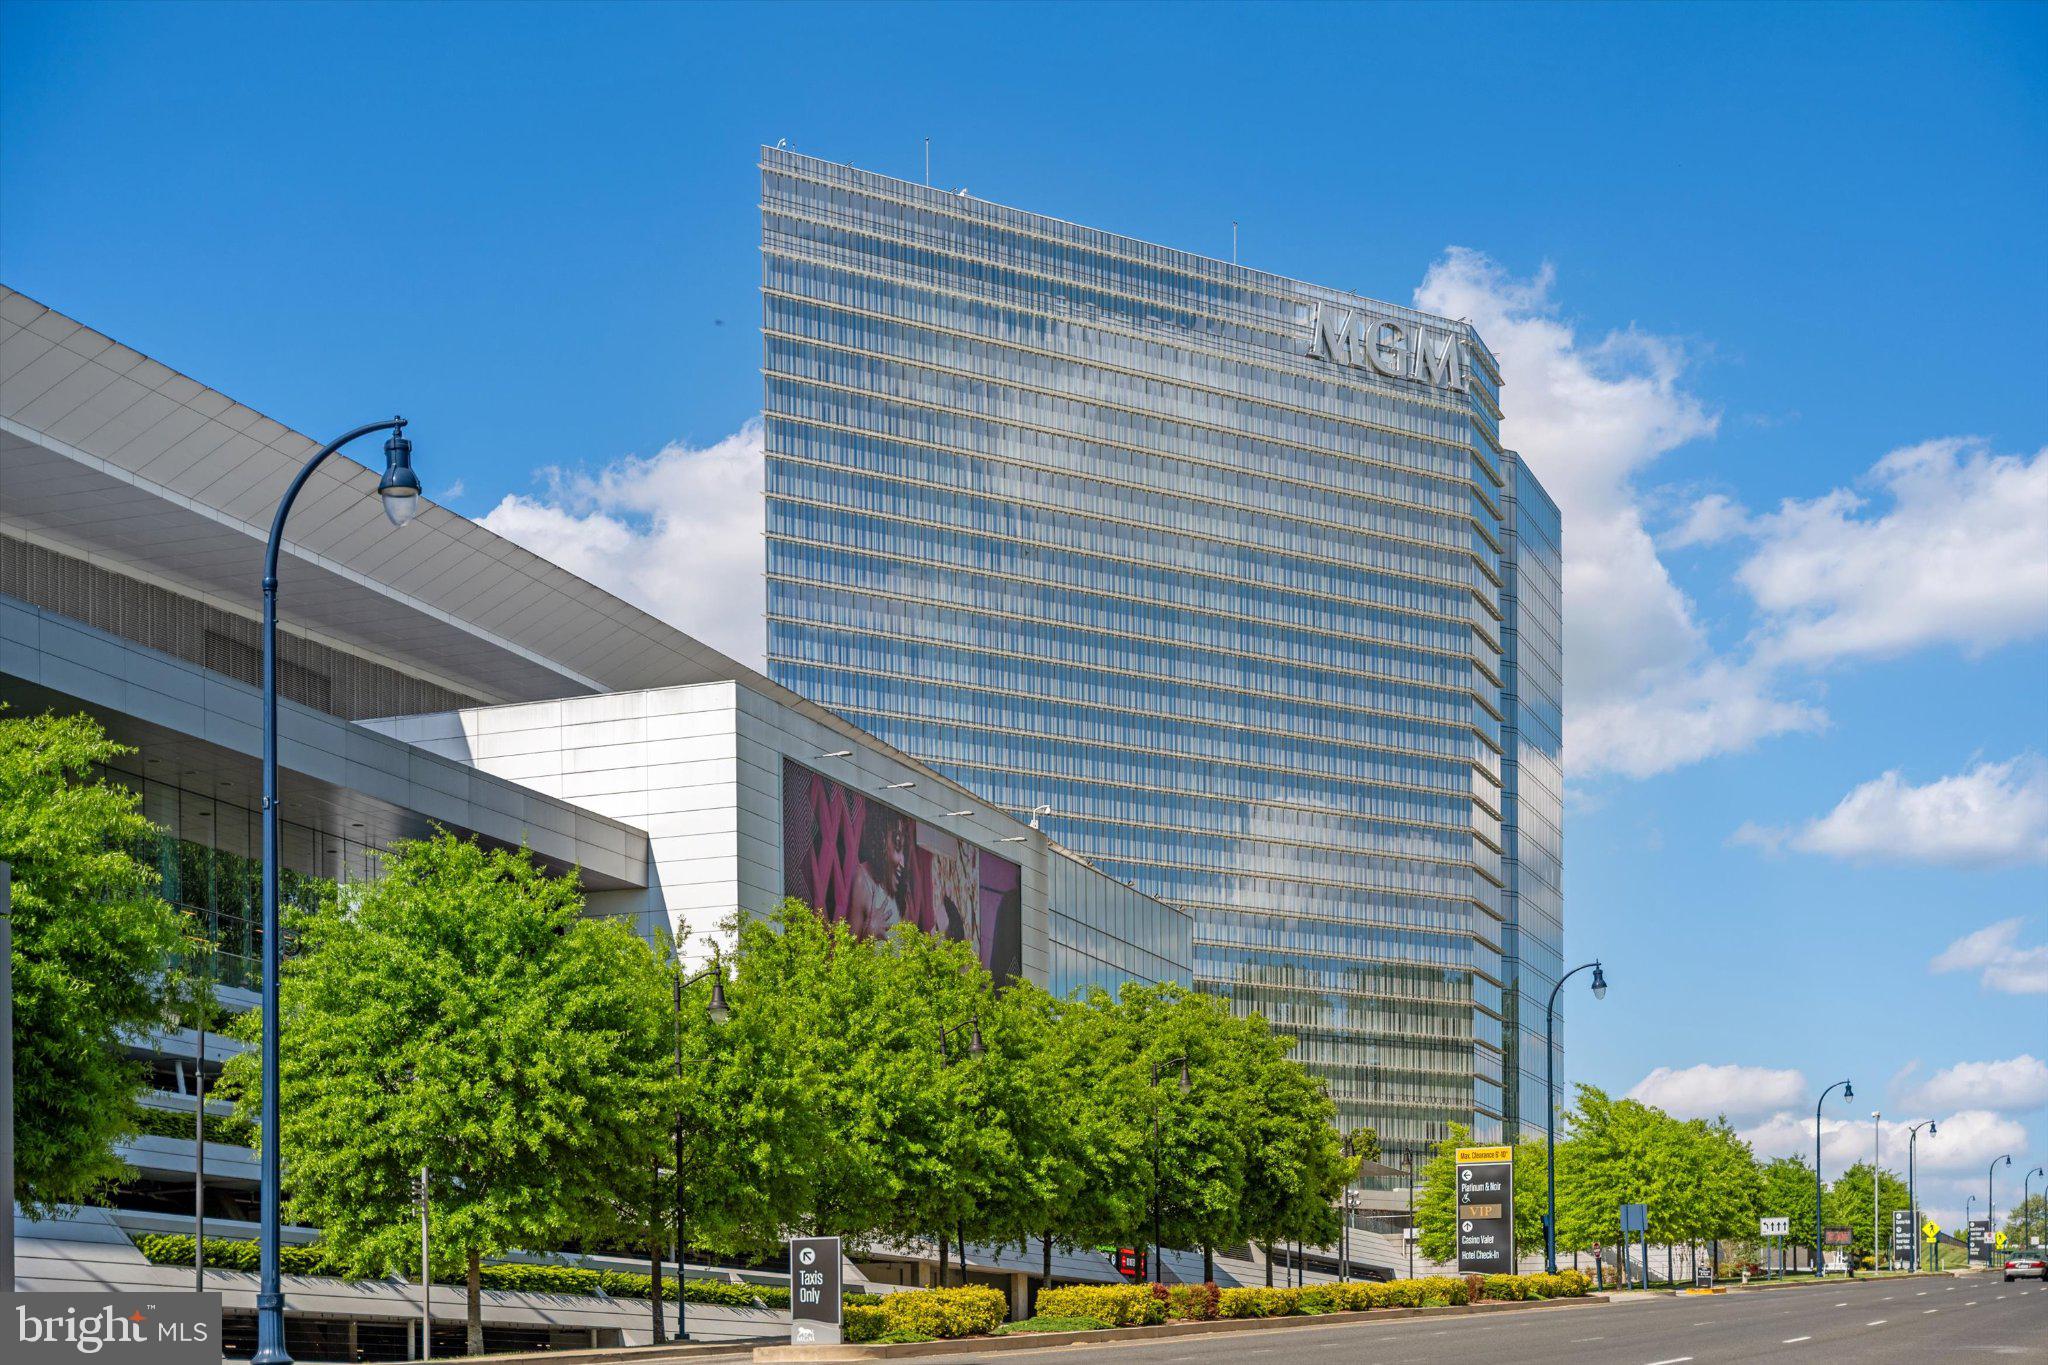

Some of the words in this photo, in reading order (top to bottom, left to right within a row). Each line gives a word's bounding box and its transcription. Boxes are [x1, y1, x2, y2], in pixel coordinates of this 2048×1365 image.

[1305, 301, 1465, 393] MGM
[1472, 1151, 1495, 1159] Clearance
[1461, 1183, 1484, 1192] Platinum
[1485, 1182, 1490, 1191] &
[1490, 1182, 1501, 1191] Noir
[1470, 1206, 1492, 1216] VIP
[1461, 1235, 1480, 1244] Casino
[1480, 1234, 1494, 1244] Valet
[1461, 1250, 1475, 1260] Hotel
[1476, 1250, 1499, 1259] Check-In
[799, 1270, 823, 1285] Taxis
[800, 1287, 820, 1304] Only
